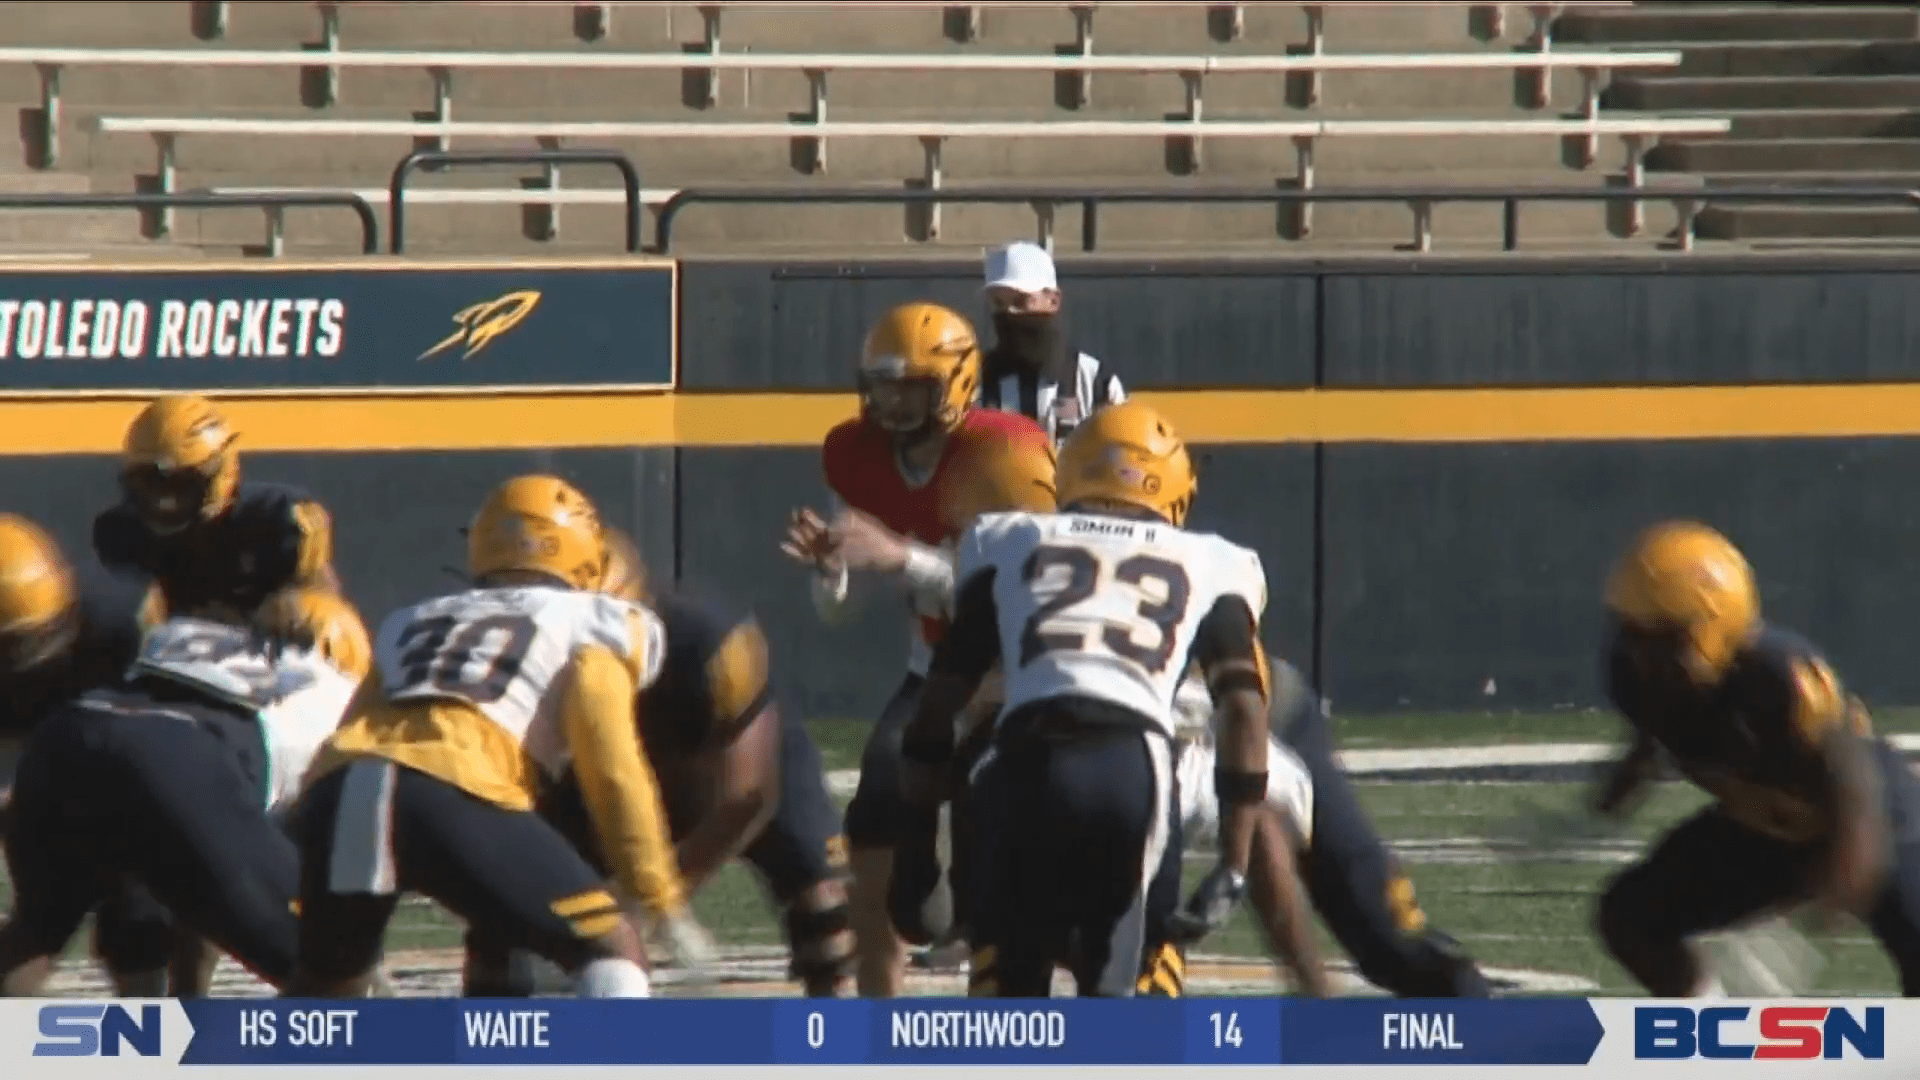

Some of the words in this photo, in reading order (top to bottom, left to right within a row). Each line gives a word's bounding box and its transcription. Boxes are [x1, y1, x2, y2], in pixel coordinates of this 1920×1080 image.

[0, 299, 148, 359] TOLEDO
[157, 298, 344, 358] ROCKETS
[1020, 546, 1190, 673] 23
